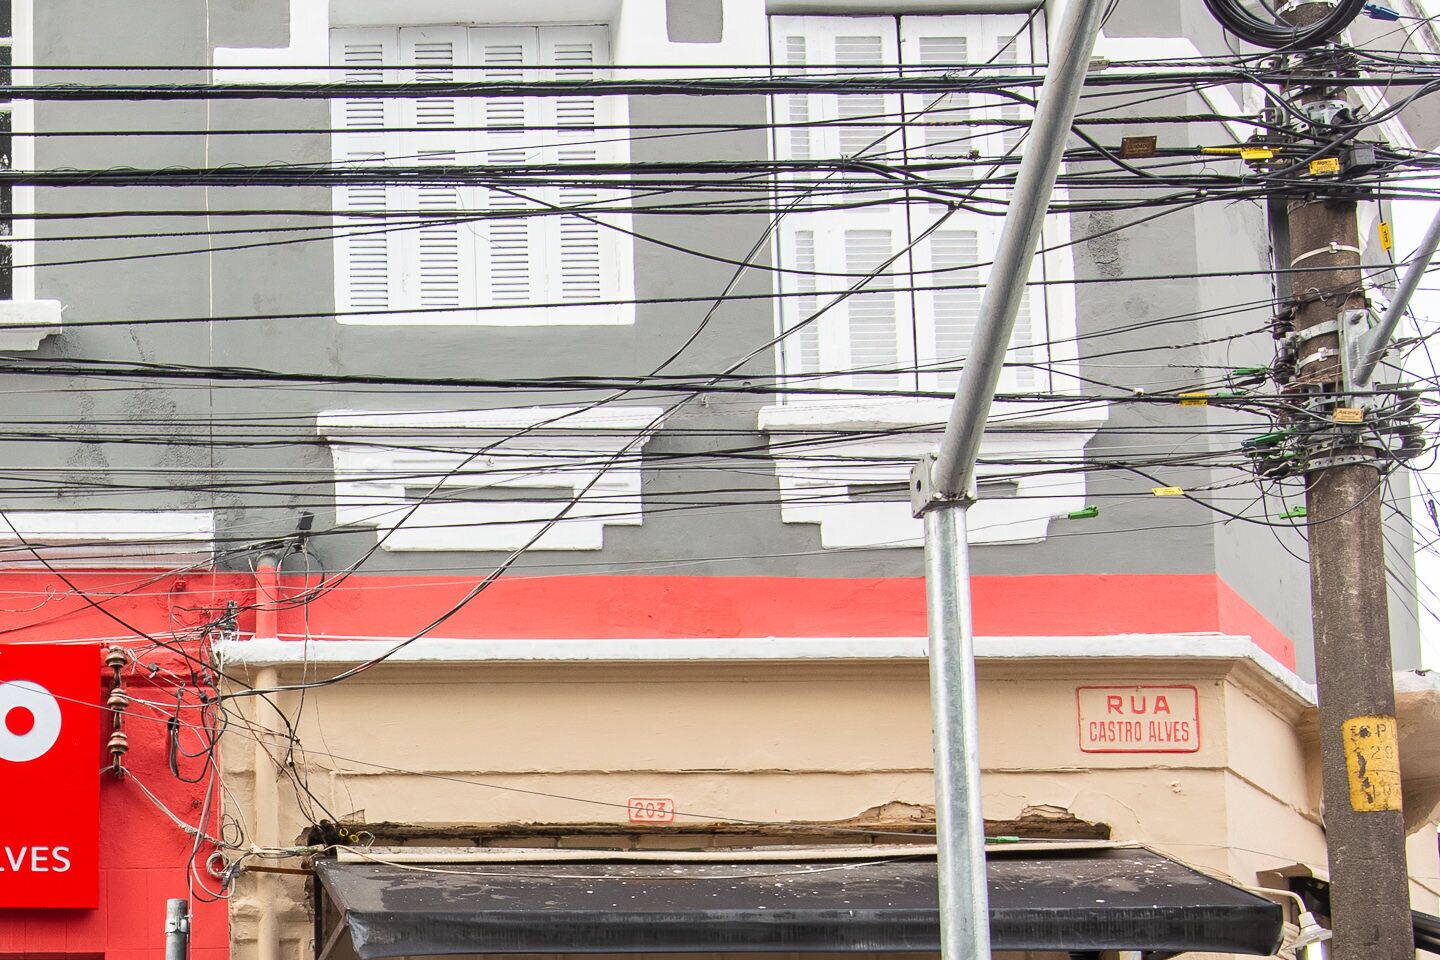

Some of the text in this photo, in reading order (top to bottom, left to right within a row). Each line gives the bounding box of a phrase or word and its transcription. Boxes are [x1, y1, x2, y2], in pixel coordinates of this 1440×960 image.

[1106, 695, 1171, 714] RUA
[1089, 721, 1190, 742] CASTRO ALVES
[634, 802, 666, 818] 203
